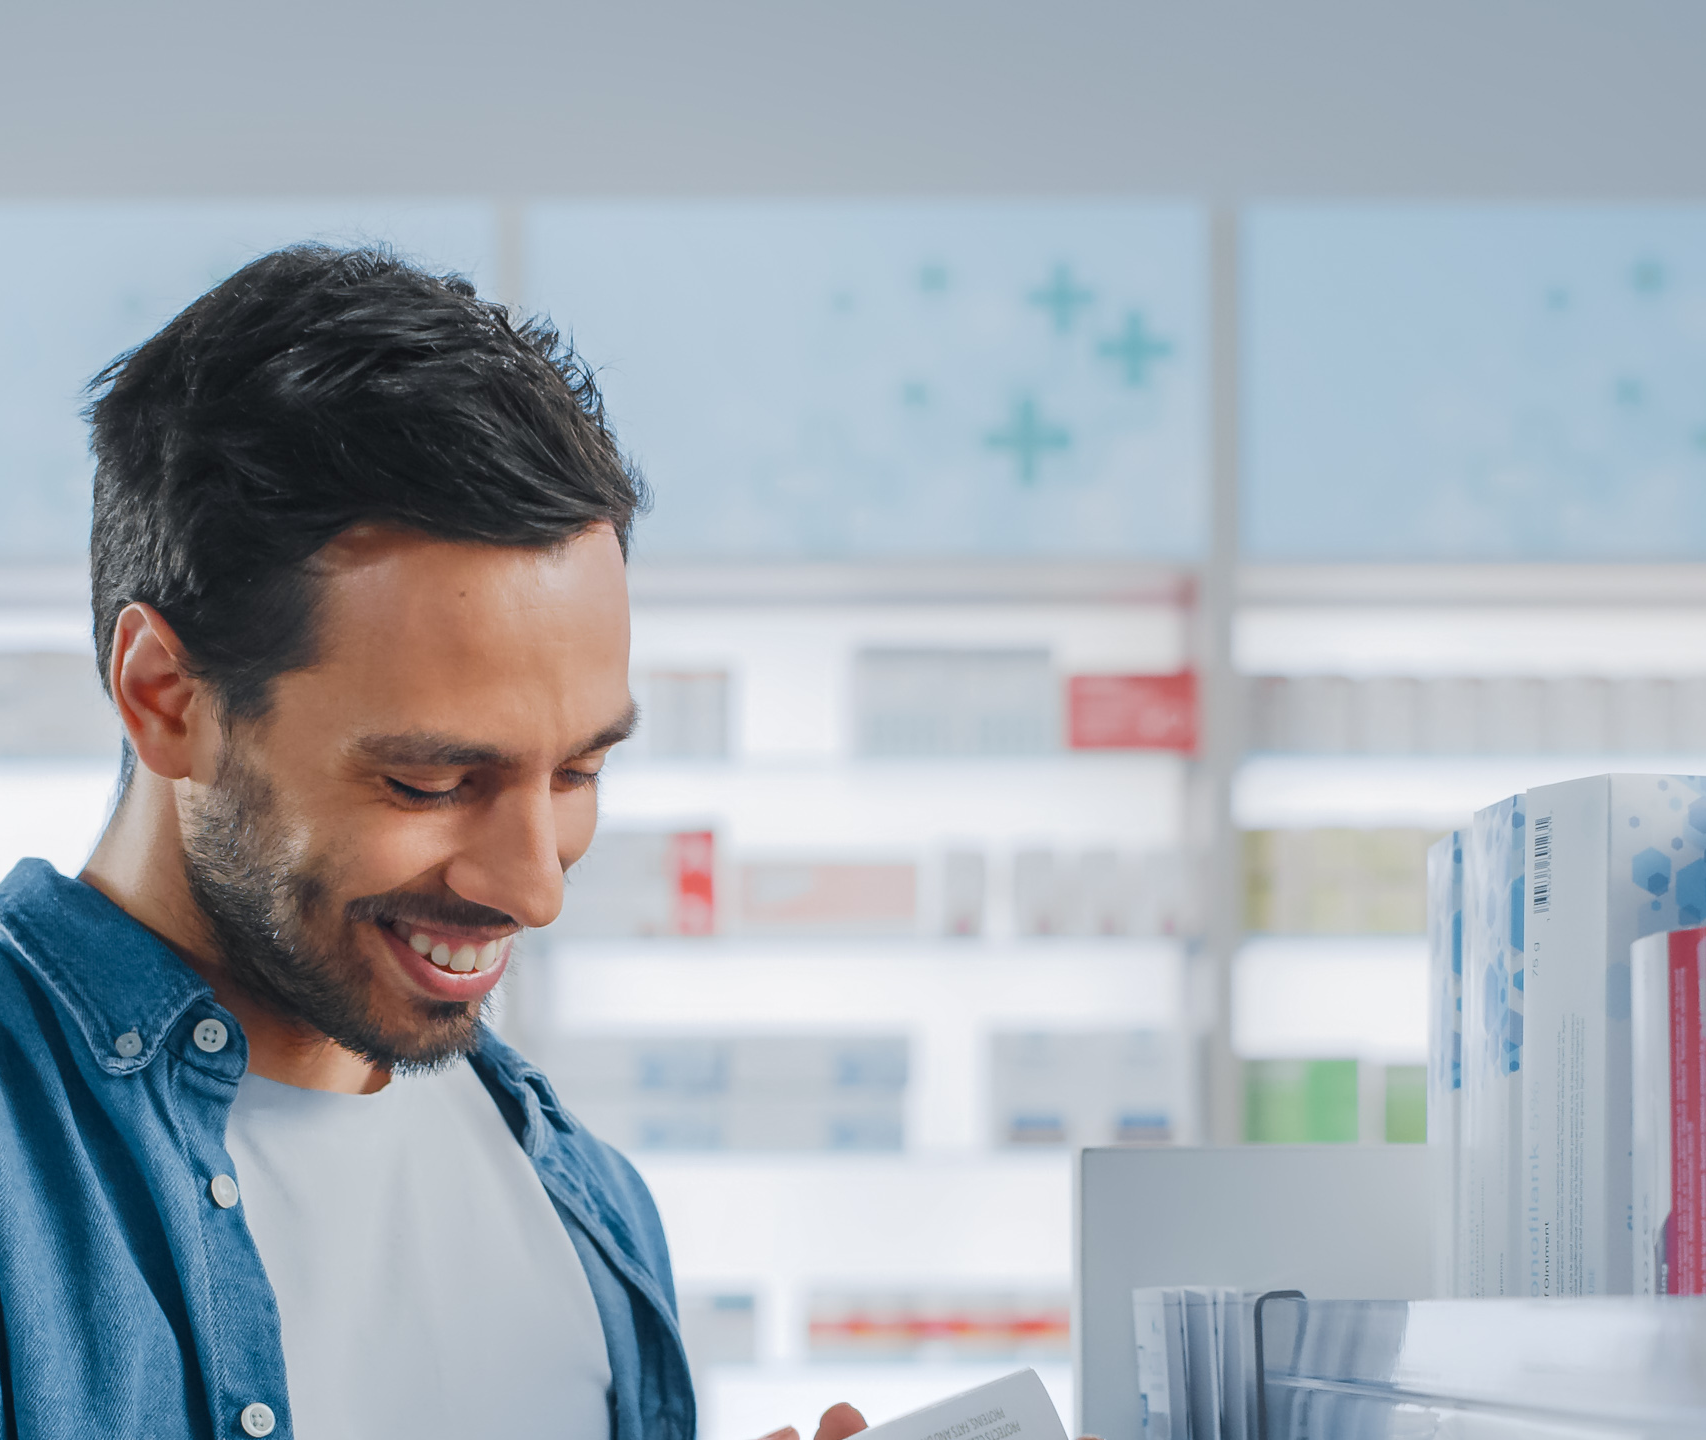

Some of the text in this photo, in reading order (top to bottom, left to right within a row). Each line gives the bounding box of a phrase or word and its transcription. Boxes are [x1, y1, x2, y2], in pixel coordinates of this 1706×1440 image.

[1532, 958, 1539, 978] 75
[966, 1406, 1005, 1430] PROTEINS,
[950, 1420, 970, 1438] FATS
